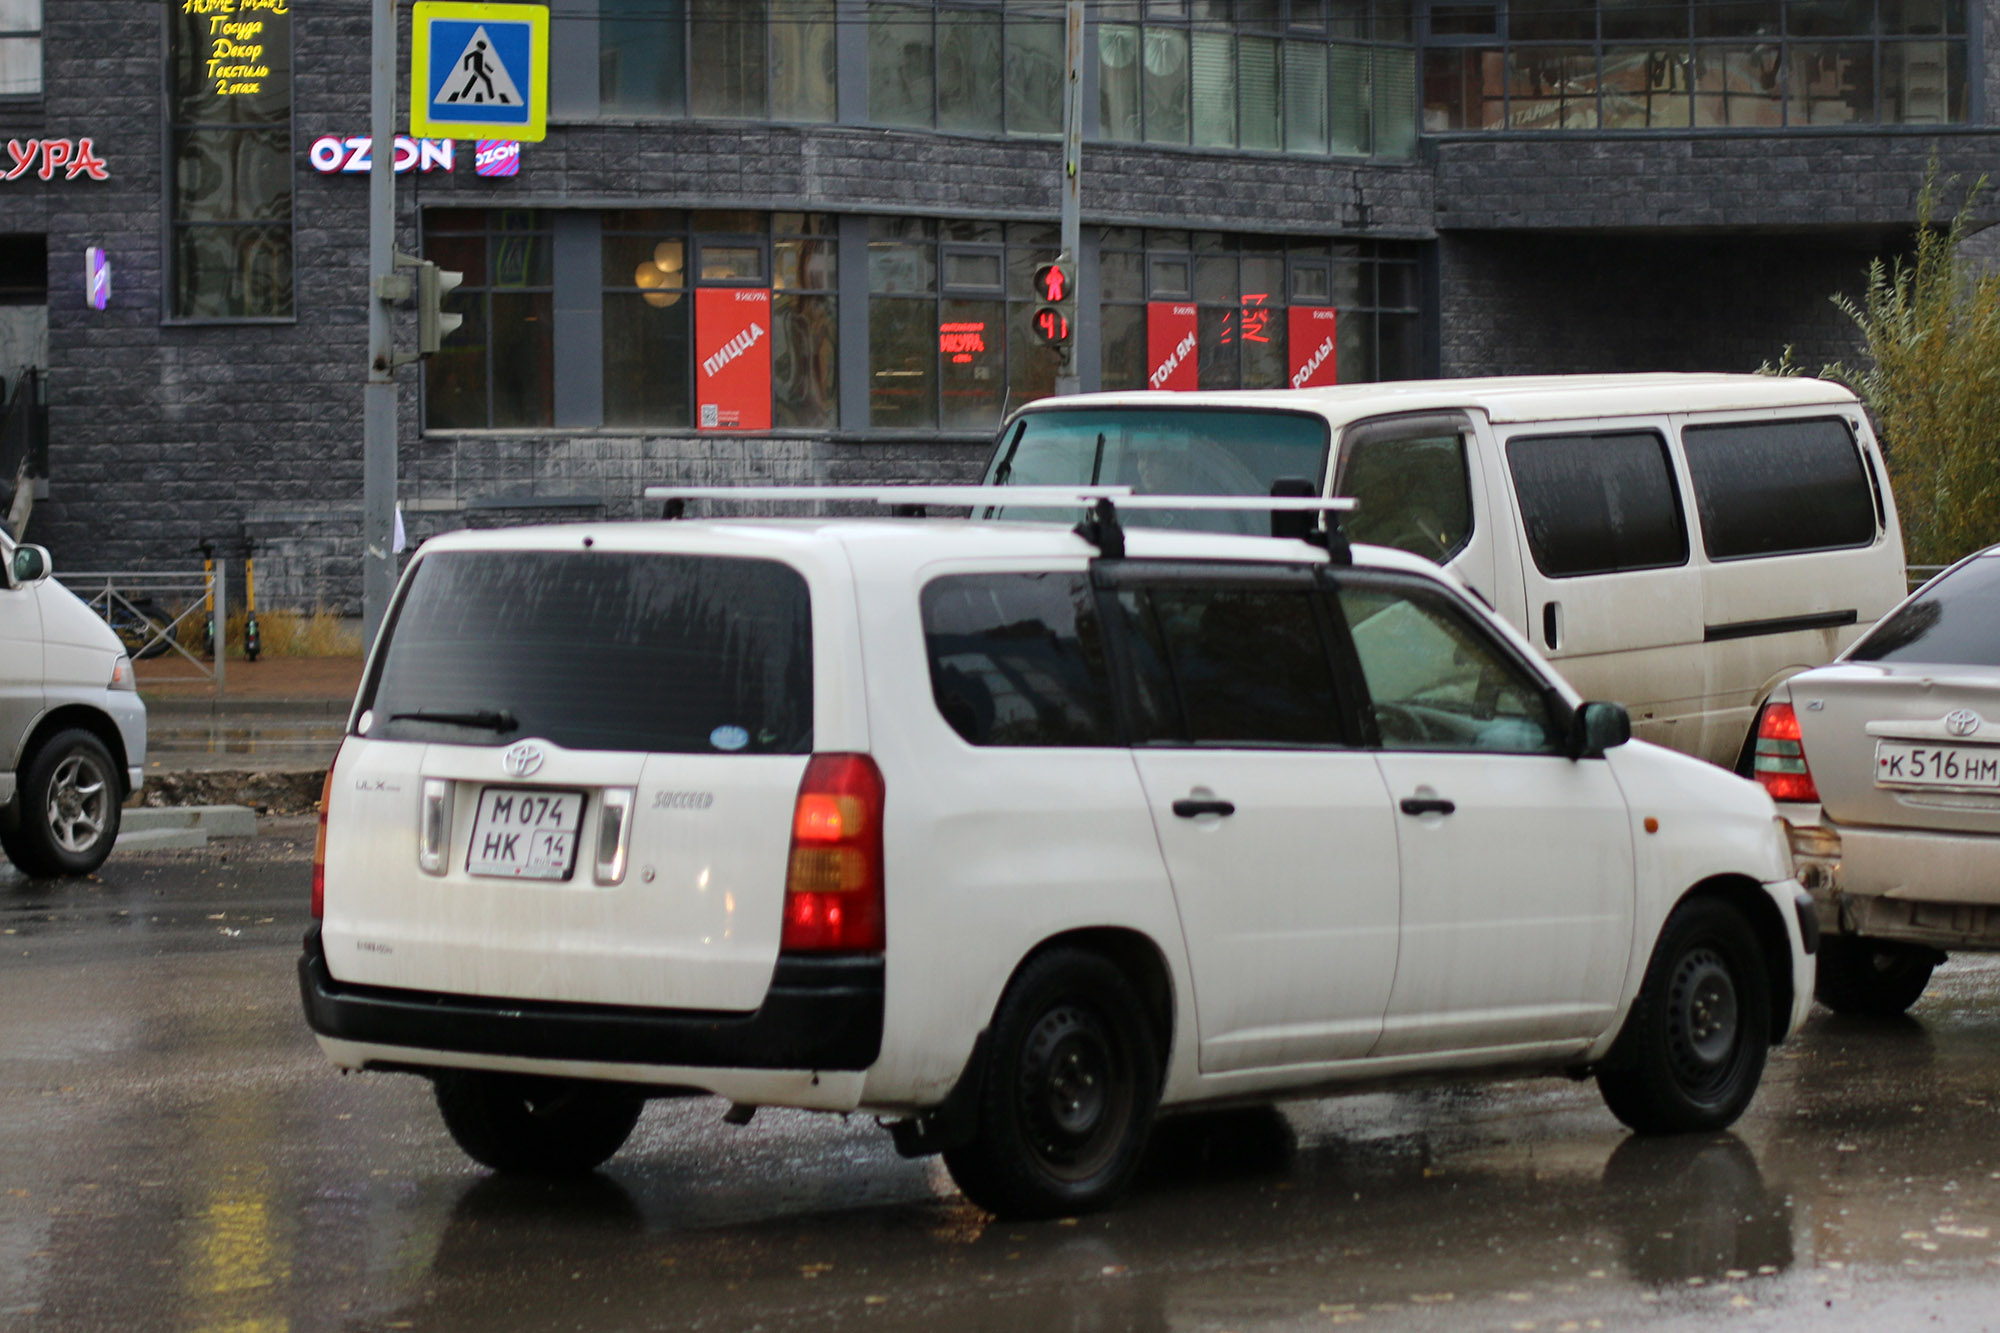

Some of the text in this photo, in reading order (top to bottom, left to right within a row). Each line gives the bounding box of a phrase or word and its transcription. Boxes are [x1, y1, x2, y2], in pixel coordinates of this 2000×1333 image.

[209, 15, 263, 40] Посуда
[211, 38, 263, 63] Декор
[205, 58, 270, 78] Текстиль
[215, 79, 261, 95] 2 этаж
[0, 138, 109, 181] УРА
[309, 136, 454, 173] OZON
[1040, 312, 1068, 339] 41
[703, 322, 765, 377] ПИЦЦА
[1150, 352, 1178, 389] ТОМ
[1176, 331, 1196, 361] ЯМ
[1292, 336, 1334, 390] РОЛЛЫ
[482, 833, 520, 861] НК
[544, 836, 564, 856] 14
